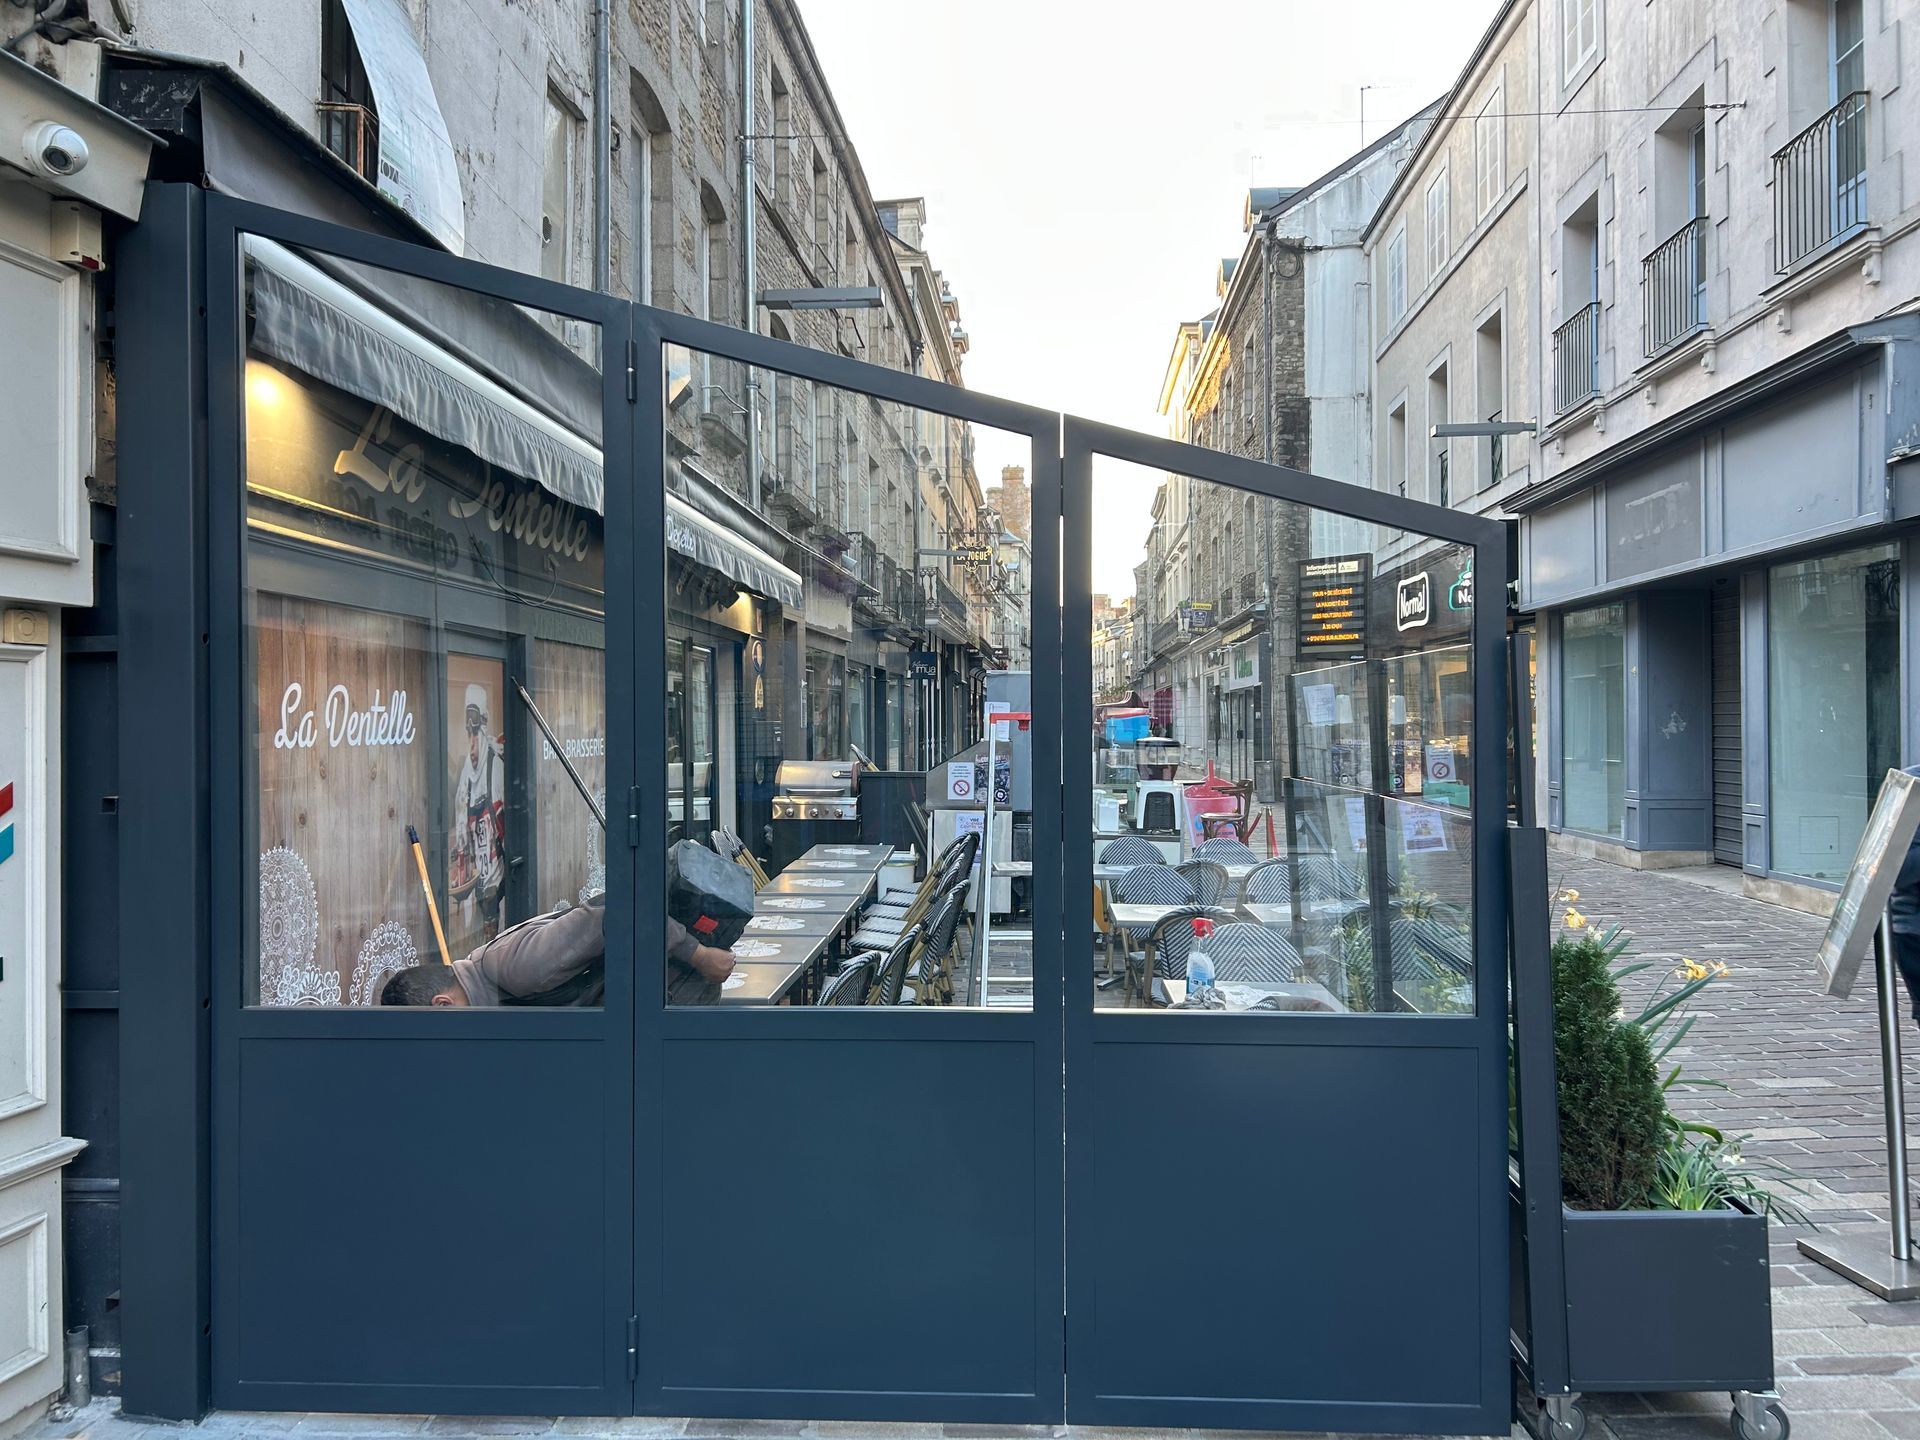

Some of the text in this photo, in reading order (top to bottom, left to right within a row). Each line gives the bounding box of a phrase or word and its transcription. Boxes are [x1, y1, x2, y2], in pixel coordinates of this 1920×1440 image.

[1400, 583, 1425, 619] Normal
[274, 682, 416, 749] La Dentelle
[566, 737, 604, 758] BRASSERIE
